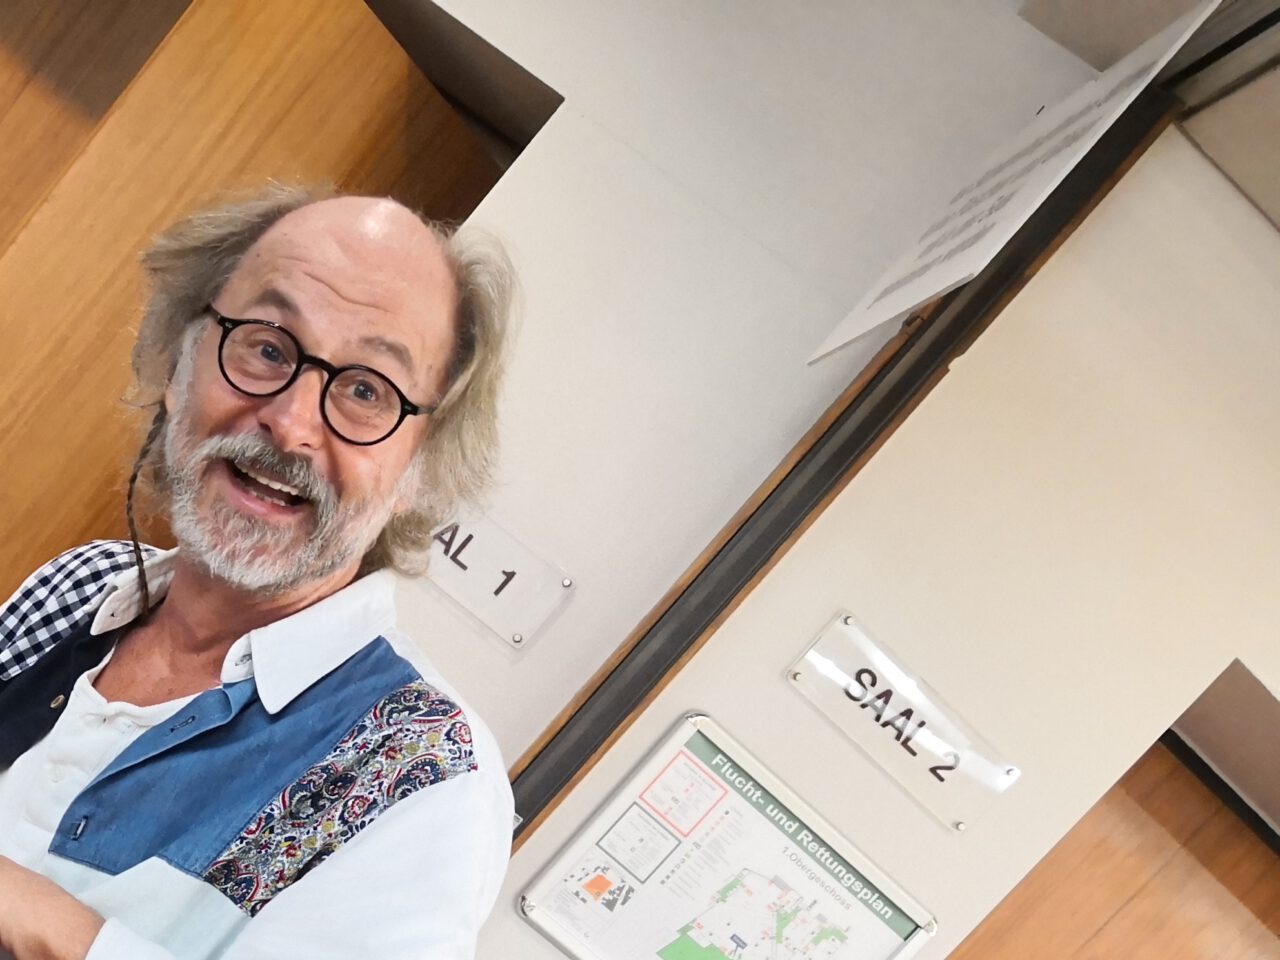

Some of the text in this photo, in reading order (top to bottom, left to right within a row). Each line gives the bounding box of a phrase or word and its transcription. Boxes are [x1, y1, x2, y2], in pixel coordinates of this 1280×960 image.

[432, 522, 517, 597] AL 1
[843, 667, 961, 783] SAAL 2
[711, 753, 765, 806] Flucht-
[765, 802, 800, 834] und
[796, 829, 895, 920] Rettungsplan
